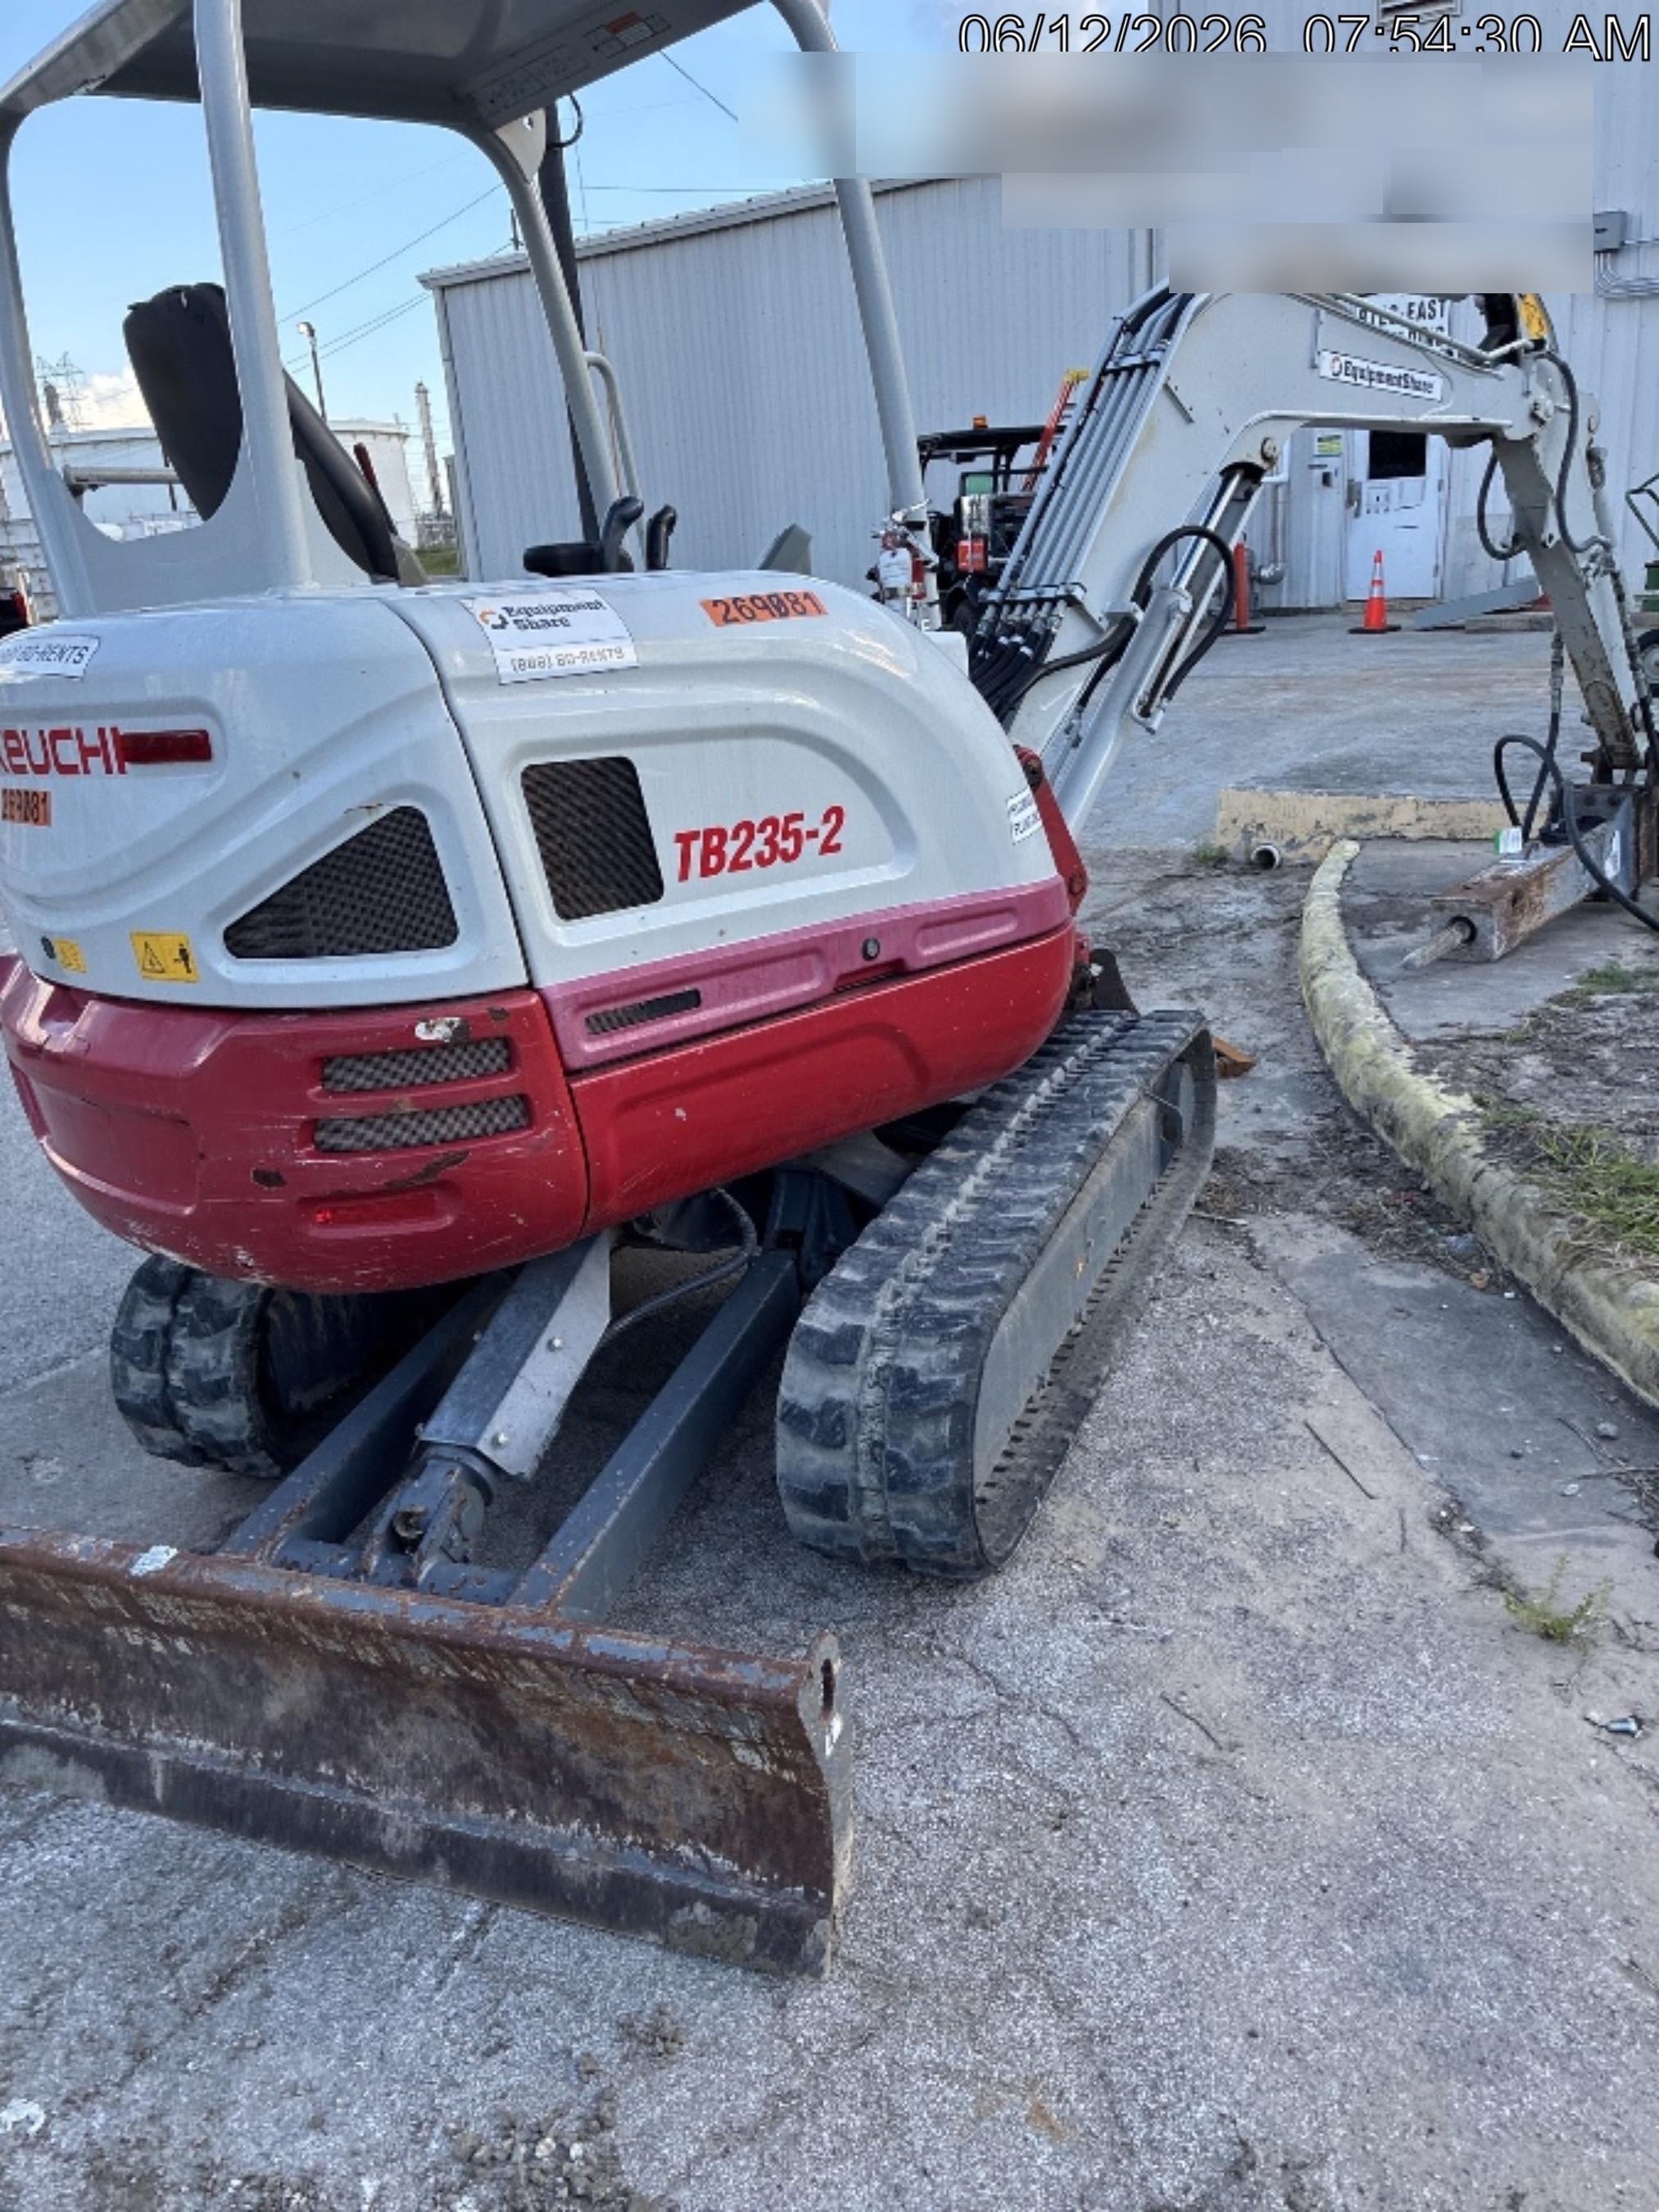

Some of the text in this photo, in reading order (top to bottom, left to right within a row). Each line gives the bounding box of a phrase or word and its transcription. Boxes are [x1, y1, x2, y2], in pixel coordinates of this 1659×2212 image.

[1407, 299, 1446, 320] EAST
[1344, 360, 1434, 394] EquipmentShare
[501, 599, 607, 617] Equipment
[512, 617, 571, 631] Share
[712, 592, 823, 624] 269081
[0, 726, 127, 775] EUCHI
[673, 805, 845, 882] TB235-2
